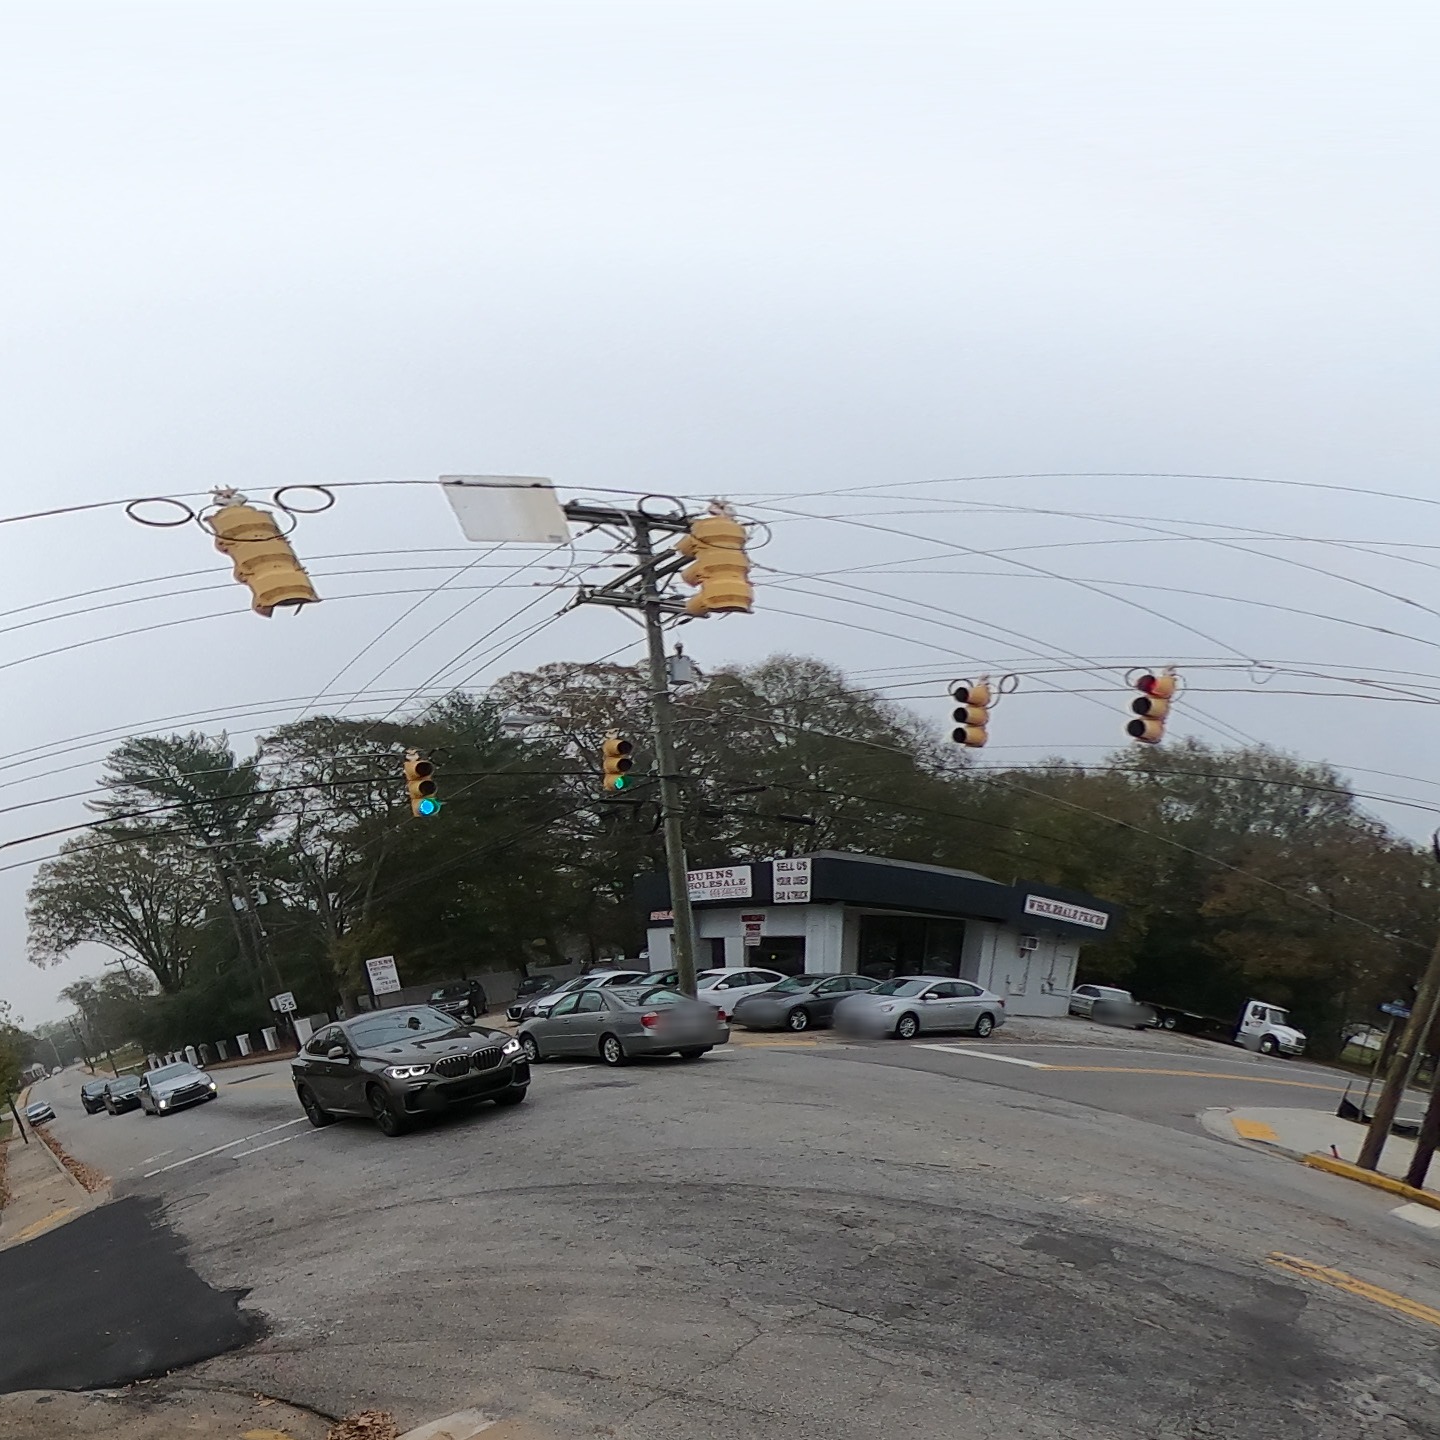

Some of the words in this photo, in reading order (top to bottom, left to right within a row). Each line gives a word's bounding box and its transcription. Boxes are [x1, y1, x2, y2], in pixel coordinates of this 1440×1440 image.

[687, 869, 733, 882] BURNS
[688, 878, 746, 890] HOLESALE
[282, 1001, 295, 1011] 25
